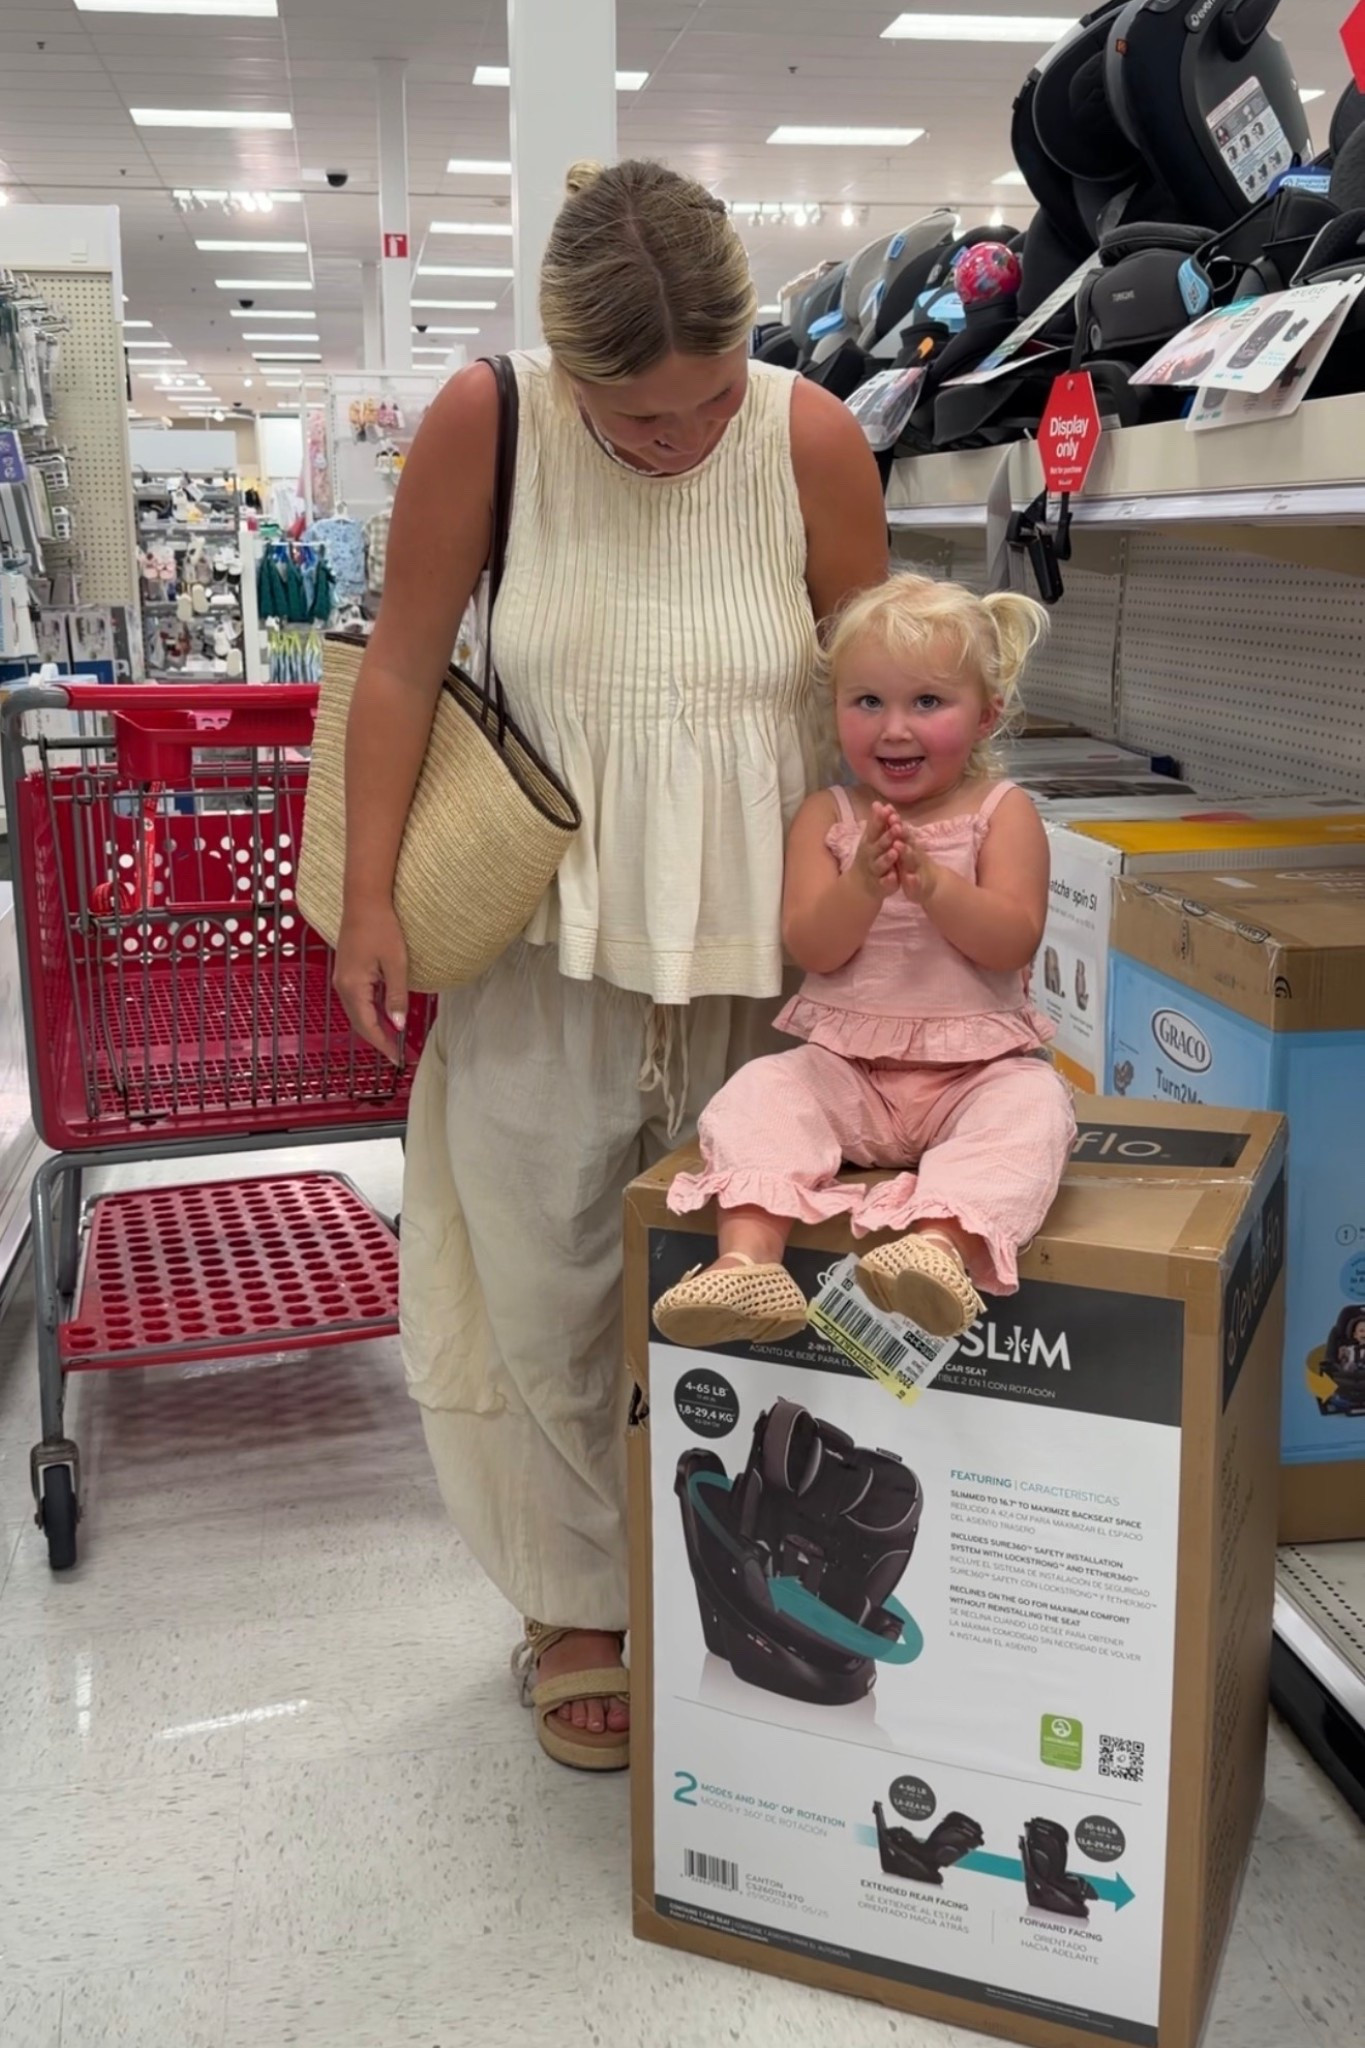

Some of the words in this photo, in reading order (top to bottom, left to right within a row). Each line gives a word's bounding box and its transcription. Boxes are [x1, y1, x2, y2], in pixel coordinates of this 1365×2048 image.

[1049, 414, 1089, 440] Display
[1056, 437, 1079, 461] only
[1160, 1017, 1205, 1063] GRACO
[784, 1350, 795, 1359] DE
[818, 1355, 840, 1366] PARA
[960, 1319, 1071, 1371] SLIM
[945, 1363, 964, 1373] CAR
[965, 1366, 988, 1377] SEAT
[968, 1378, 981, 1388] EN
[987, 1380, 1007, 1391] CON
[685, 1381, 711, 1394] 4-65
[678, 1403, 717, 1420] 1,8-29,4
[951, 1469, 1012, 1488] FEATURING
[951, 1490, 985, 1502] SLIMMED
[987, 1495, 998, 1504] TO
[1019, 1501, 1029, 1510] TO
[1031, 1503, 1070, 1517] MAXIMIZE
[1072, 1510, 1113, 1523] BACKSEAT
[1115, 1518, 1142, 1529] SPACE
[951, 1531, 989, 1545] INCLUDES
[1034, 1546, 1064, 1558] SAFETY
[1066, 1552, 1123, 1569] INSTALLATION
[951, 1543, 981, 1555] SYSTEM
[983, 1549, 1003, 1559] WITH
[1066, 1564, 1083, 1573] AND
[950, 1584, 986, 1598] RECLINES
[988, 1591, 999, 1600] ON
[1001, 1593, 1017, 1603] THE
[1019, 1597, 1030, 1606] GO
[1032, 1599, 1048, 1608] FOR
[1050, 1603, 1089, 1617] MAXIMUM
[1090, 1611, 1130, 1624] COMFORT
[950, 1596, 985, 1609] WITHOUT
[987, 1603, 1042, 1620] REINSTALLING
[1044, 1613, 1059, 1623] THE
[1061, 1616, 1080, 1627] SEAT
[674, 1771, 697, 1806] 2
[701, 1783, 733, 1799] MODES
[735, 1793, 755, 1805] AND
[781, 1805, 795, 1815] OF
[797, 1809, 845, 1828] ROTATION
[860, 1879, 908, 1898] EXTENDED
[909, 1891, 933, 1904] REAR
[936, 1897, 968, 1912] FACING
[1019, 1916, 1066, 1934] FORWARD
[1068, 1927, 1102, 1942] FACING
